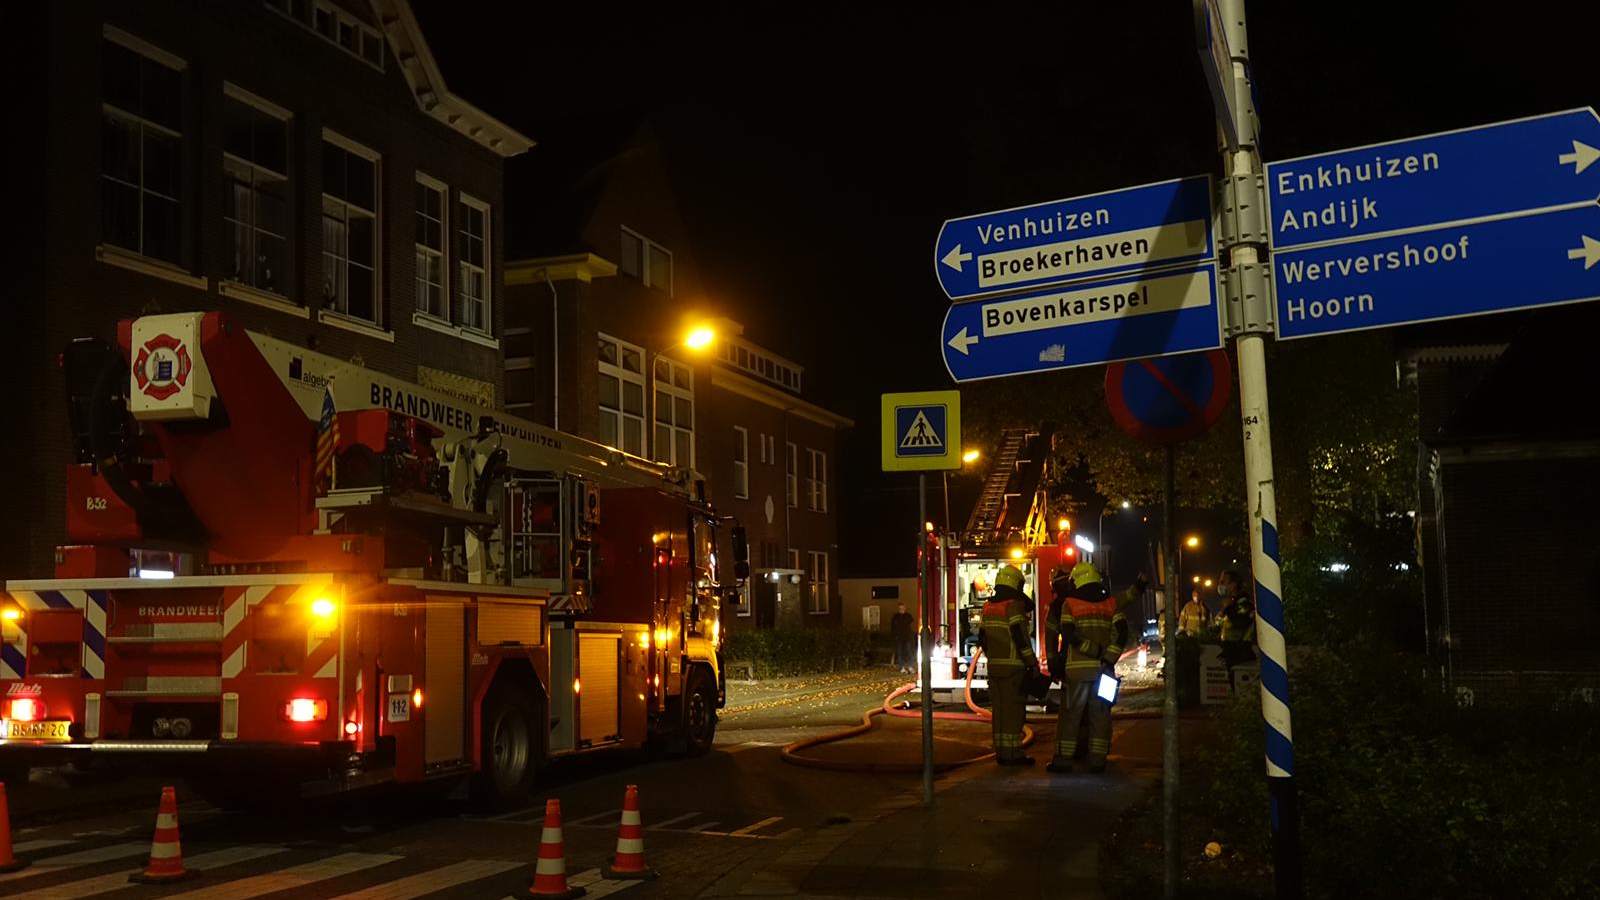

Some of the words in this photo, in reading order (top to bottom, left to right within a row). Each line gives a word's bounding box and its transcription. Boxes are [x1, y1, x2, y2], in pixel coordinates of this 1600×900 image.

[1277, 151, 1440, 195] Enkhuizen
[977, 207, 1110, 245] Venhuizen
[1279, 196, 1379, 233] Andijk
[981, 238, 1149, 279] Broekerhaven
[1281, 235, 1471, 285] Wervershoof
[986, 286, 1149, 328] Bovenkarspel
[1286, 292, 1375, 322] Hoorn
[370, 382, 473, 433] BRANDWEER
[1245, 431, 1252, 440] 2
[138, 605, 223, 617] BRANDWEER
[392, 700, 406, 714] 112
